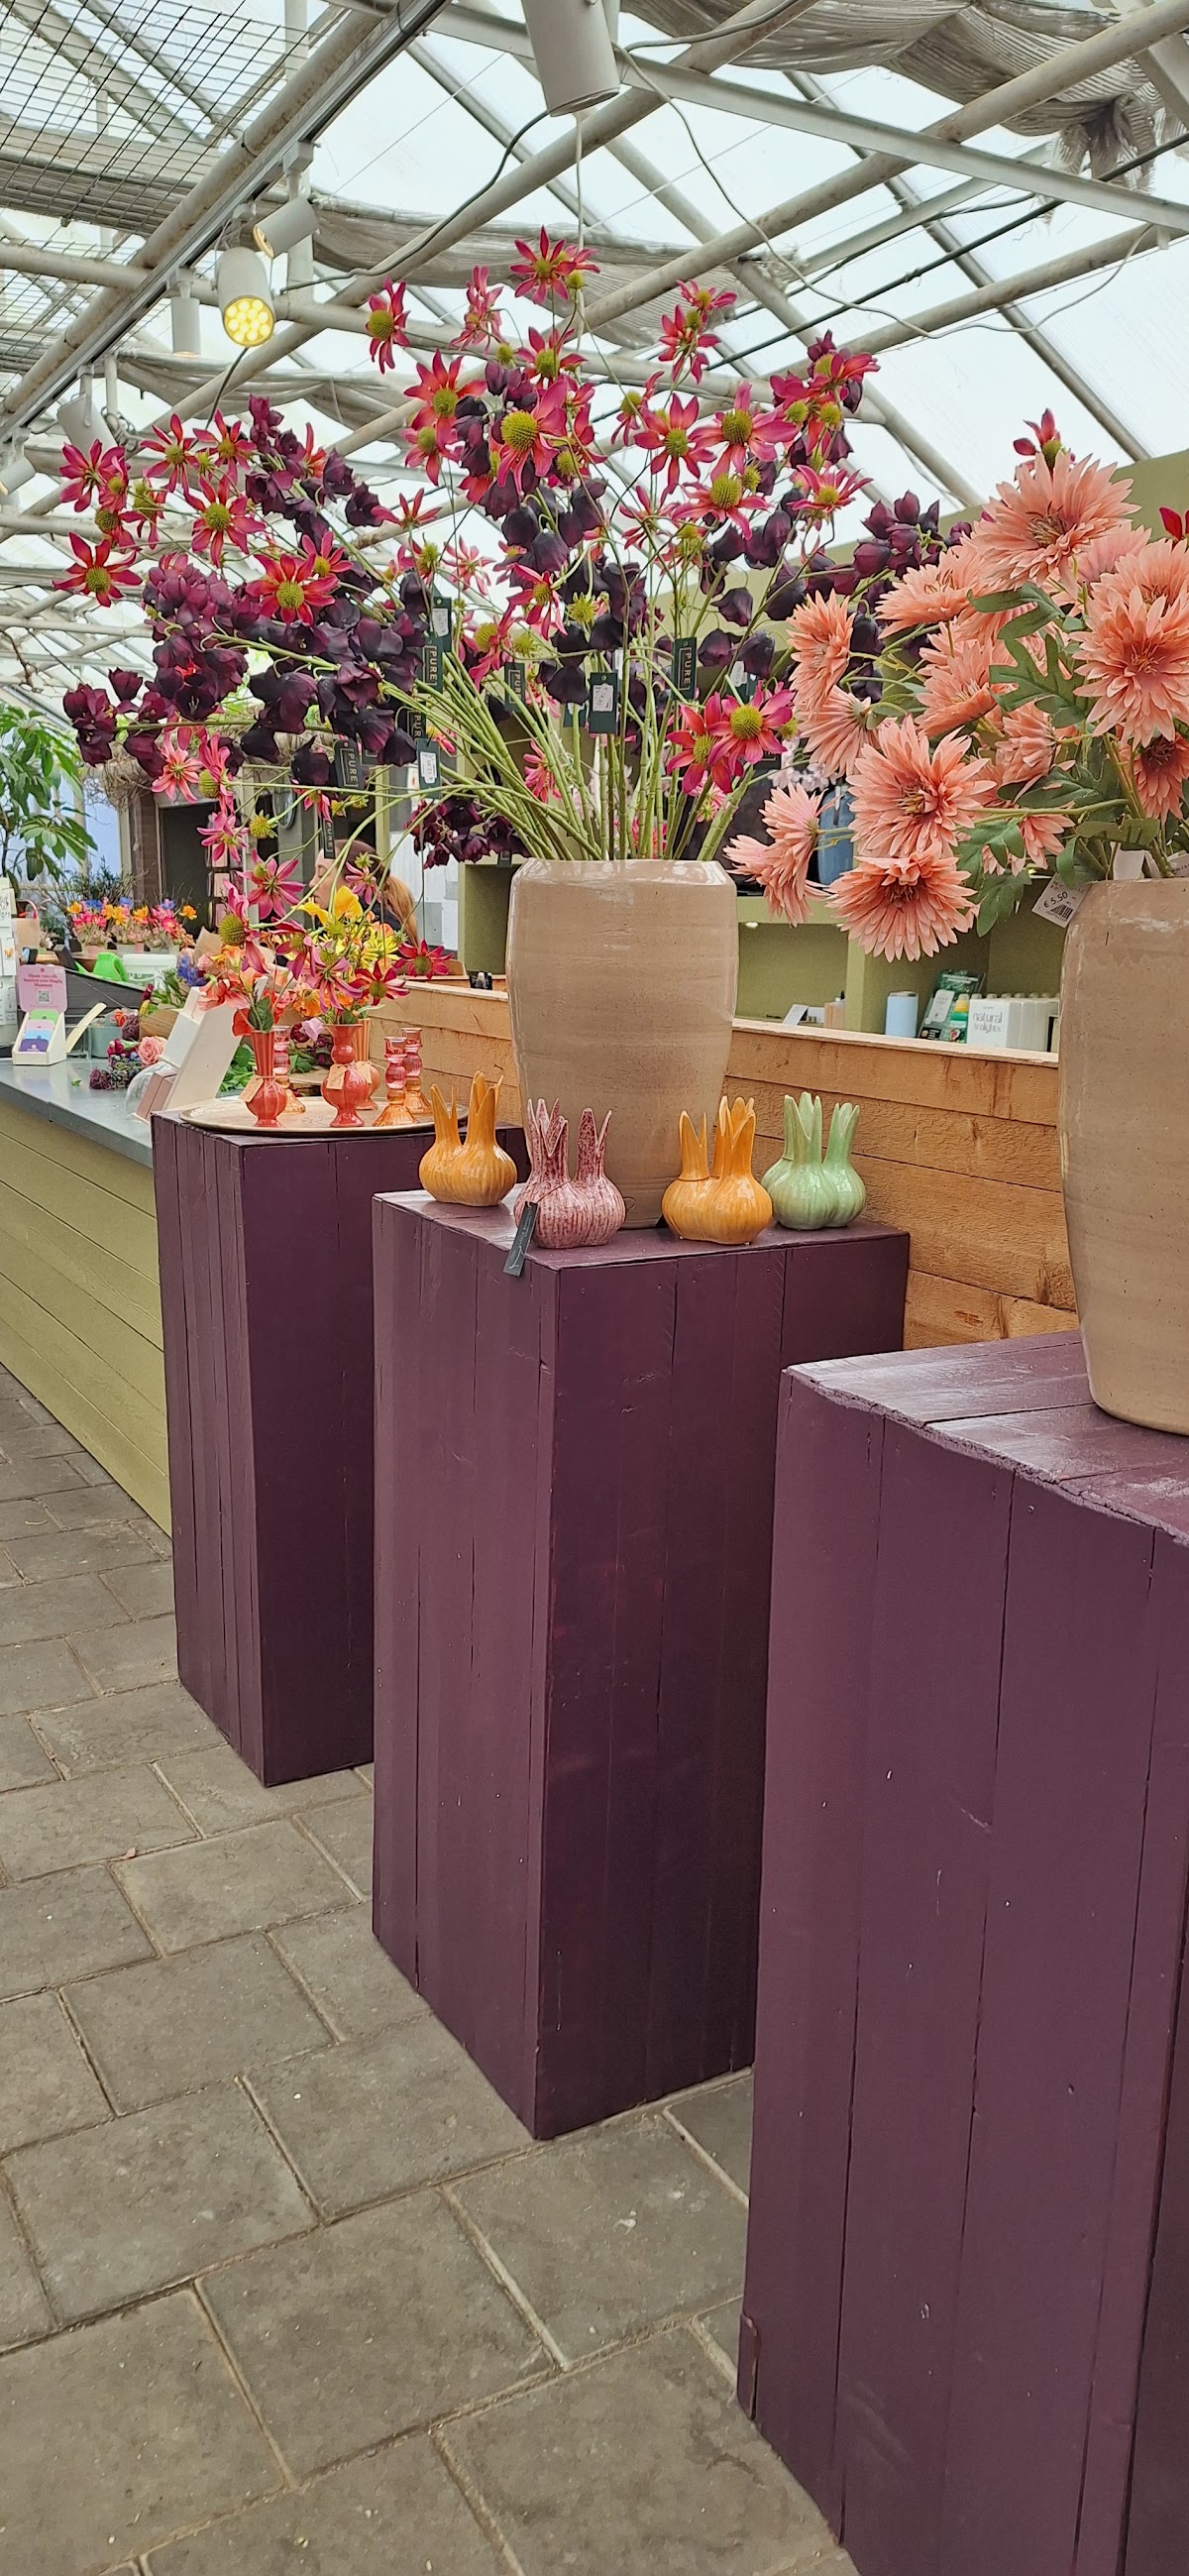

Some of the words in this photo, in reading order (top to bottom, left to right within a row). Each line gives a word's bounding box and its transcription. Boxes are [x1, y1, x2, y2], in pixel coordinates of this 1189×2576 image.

[429, 650, 438, 681] PURE
[683, 652, 693, 685] PURE
[348, 753, 359, 782] PURE
[1050, 891, 1068, 906] 5.50
[973, 1012, 1003, 1024] natural
